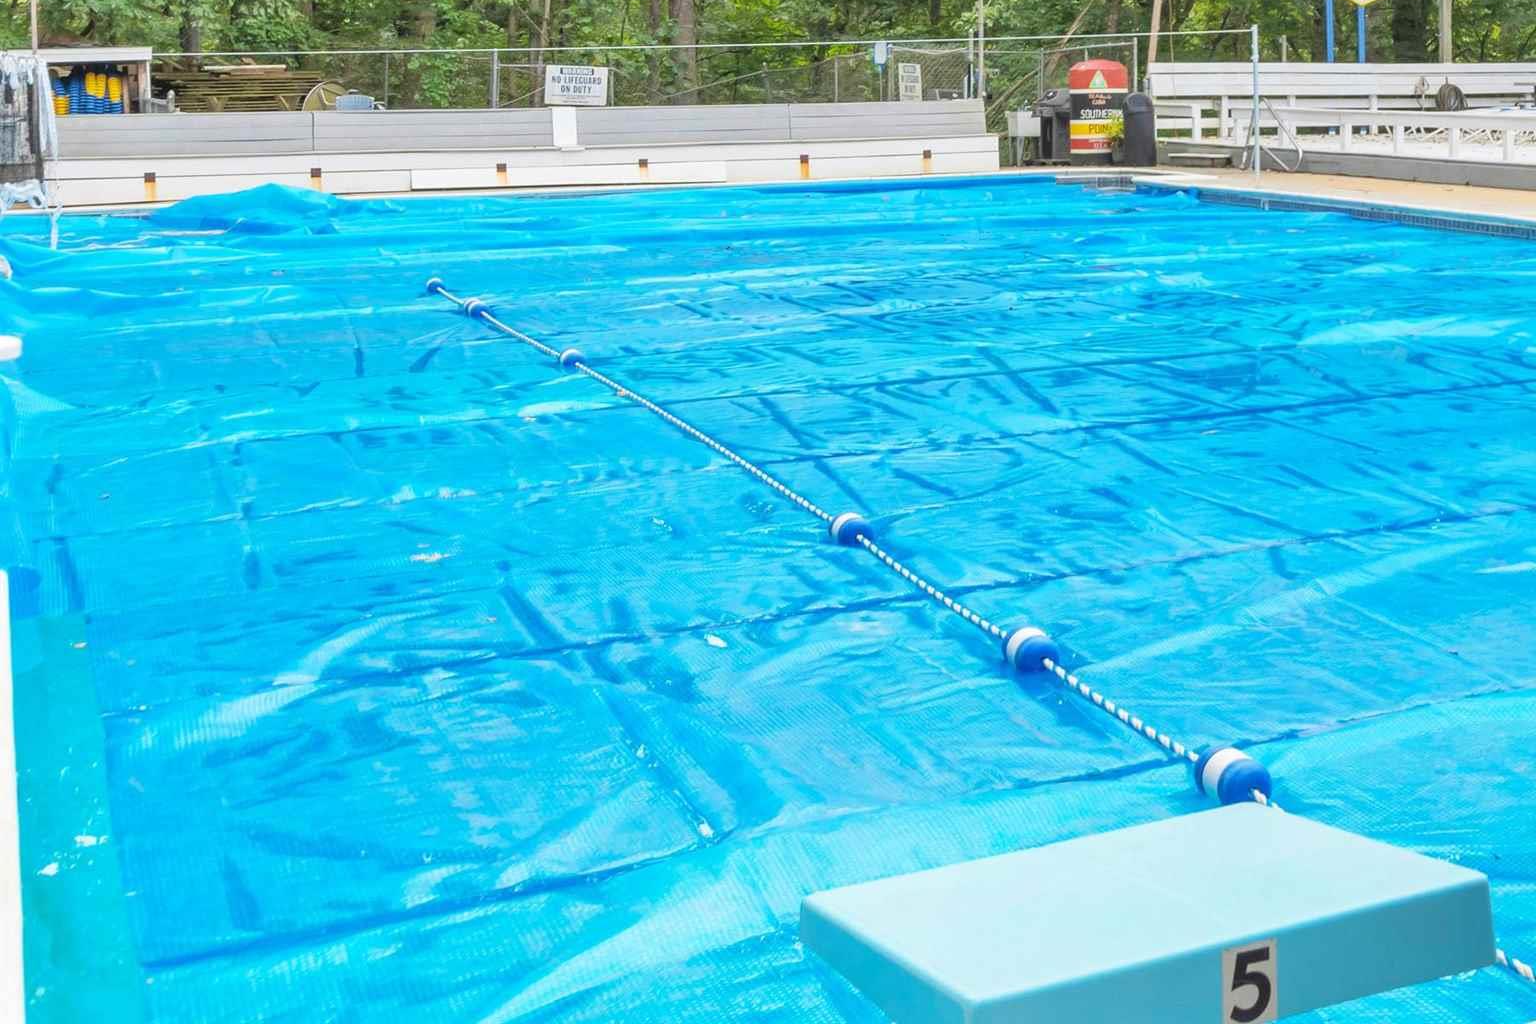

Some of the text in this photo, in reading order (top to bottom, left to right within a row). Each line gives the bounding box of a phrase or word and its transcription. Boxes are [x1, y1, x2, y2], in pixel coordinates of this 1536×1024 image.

[564, 76, 602, 85] LIFEGUARD
[560, 85, 592, 94] ON DUTY
[1230, 946, 1271, 1023] 5
